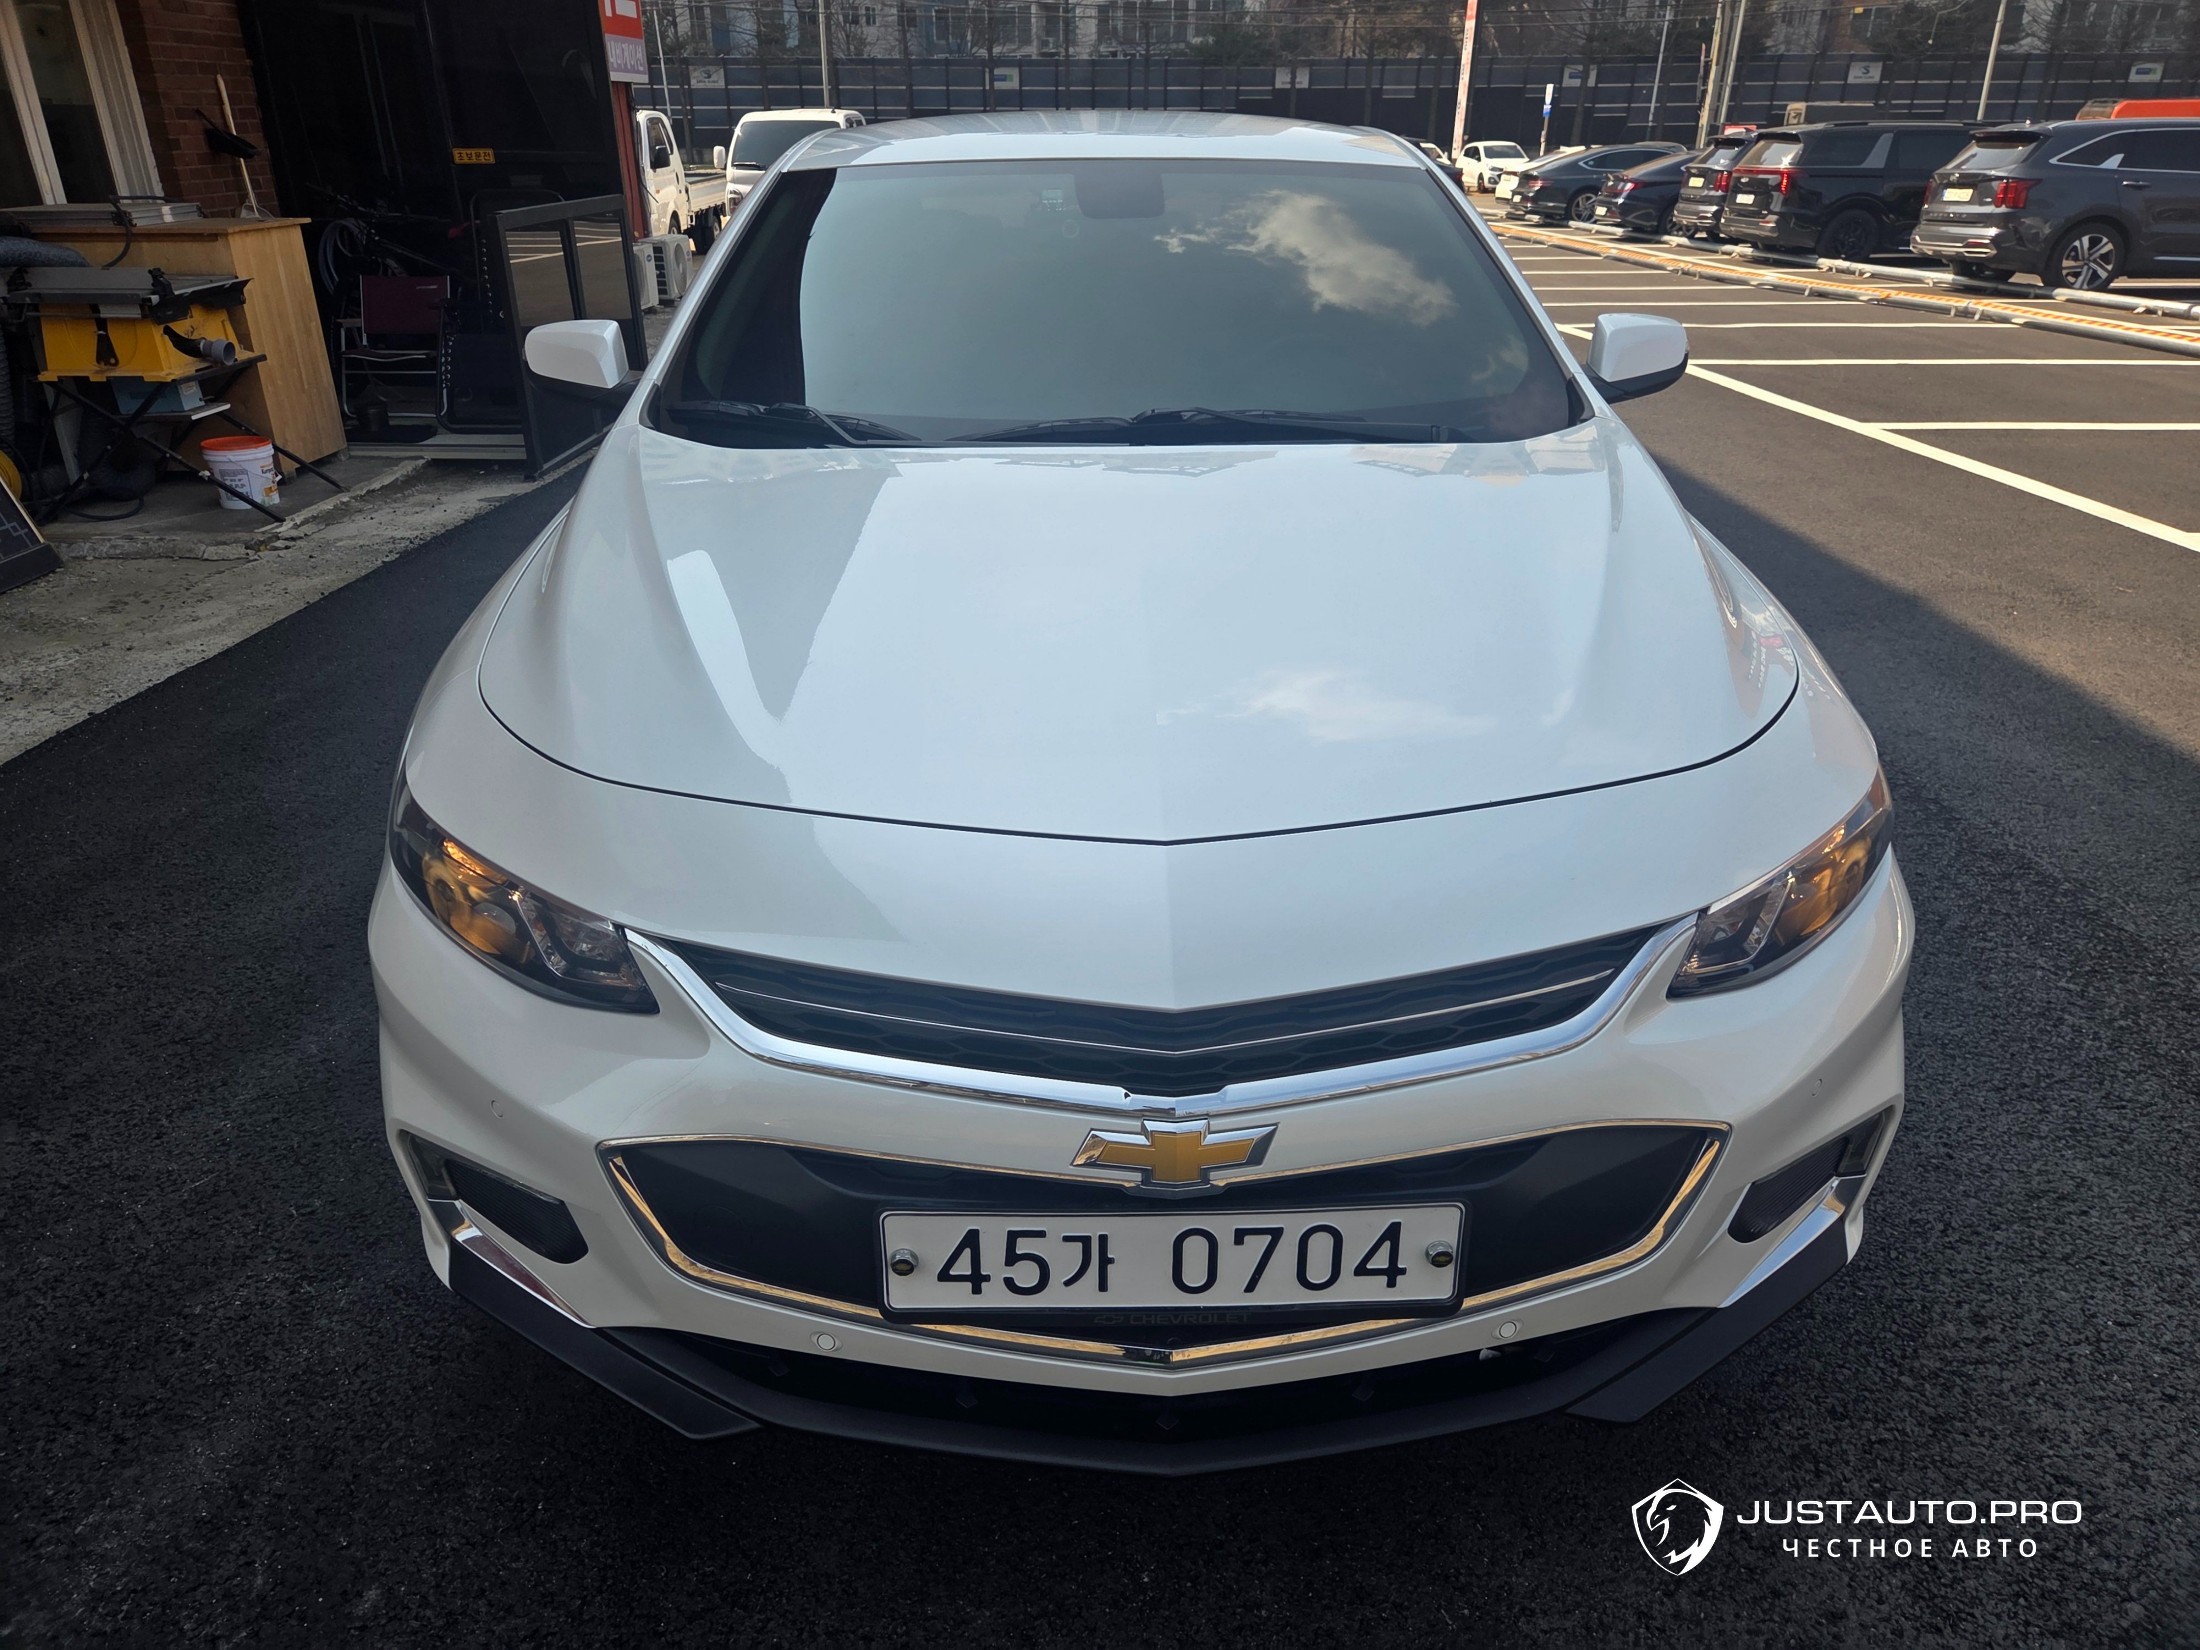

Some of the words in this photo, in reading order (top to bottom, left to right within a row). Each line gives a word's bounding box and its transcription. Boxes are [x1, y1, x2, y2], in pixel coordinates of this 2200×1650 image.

[936, 1228, 1116, 1297] 45가
[1171, 1221, 1408, 1295] 0704
[1130, 1312, 1251, 1325] CHEVROLET
